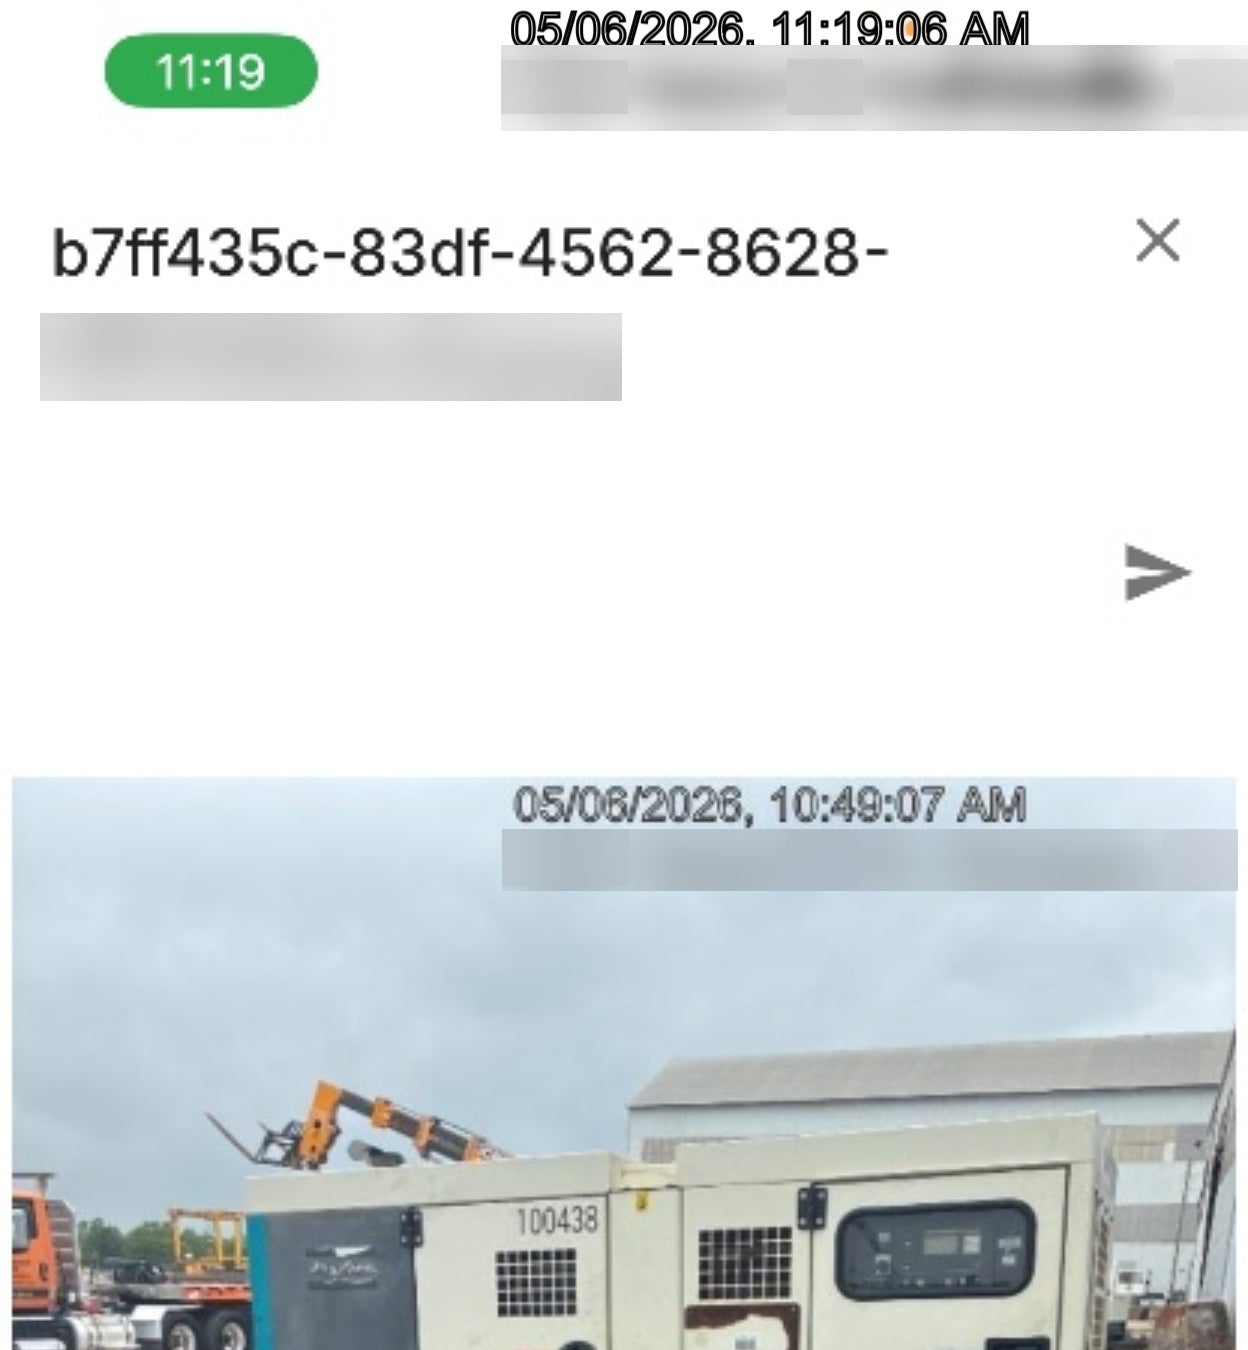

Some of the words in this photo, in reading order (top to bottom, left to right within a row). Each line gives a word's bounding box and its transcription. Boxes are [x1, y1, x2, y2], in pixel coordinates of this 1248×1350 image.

[156, 53, 266, 91] 11:19
[53, 226, 889, 278] b7ff435c-83df-4562-8628-
[517, 1205, 599, 1235] 100438
